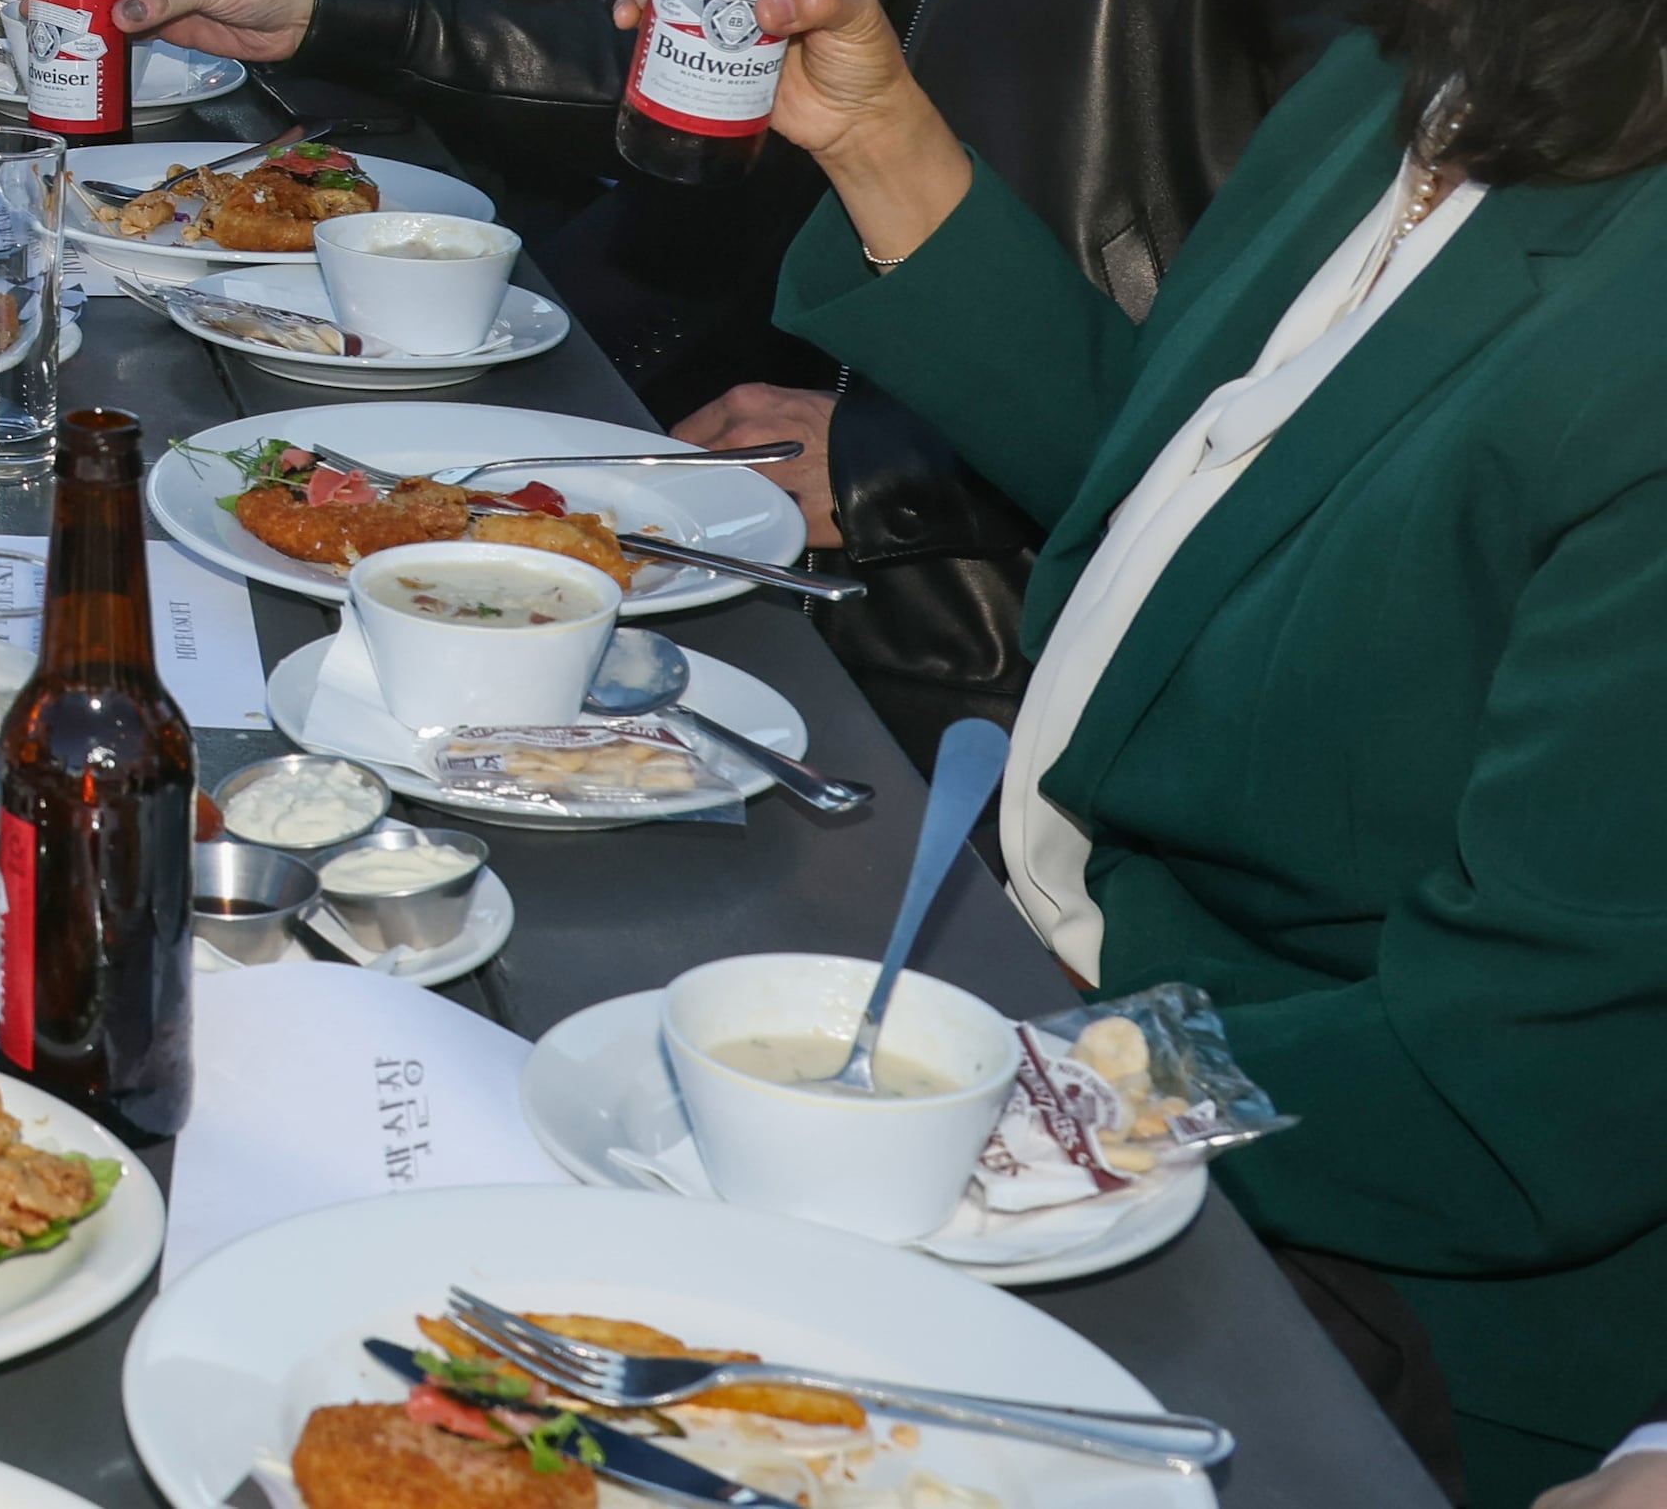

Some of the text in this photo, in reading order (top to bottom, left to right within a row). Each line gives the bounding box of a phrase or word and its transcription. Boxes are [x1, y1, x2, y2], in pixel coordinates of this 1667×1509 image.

[654, 33, 782, 78] Budweiser
[96, 59, 105, 120] GENUINE
[374, 1056, 433, 1193] 책실장
